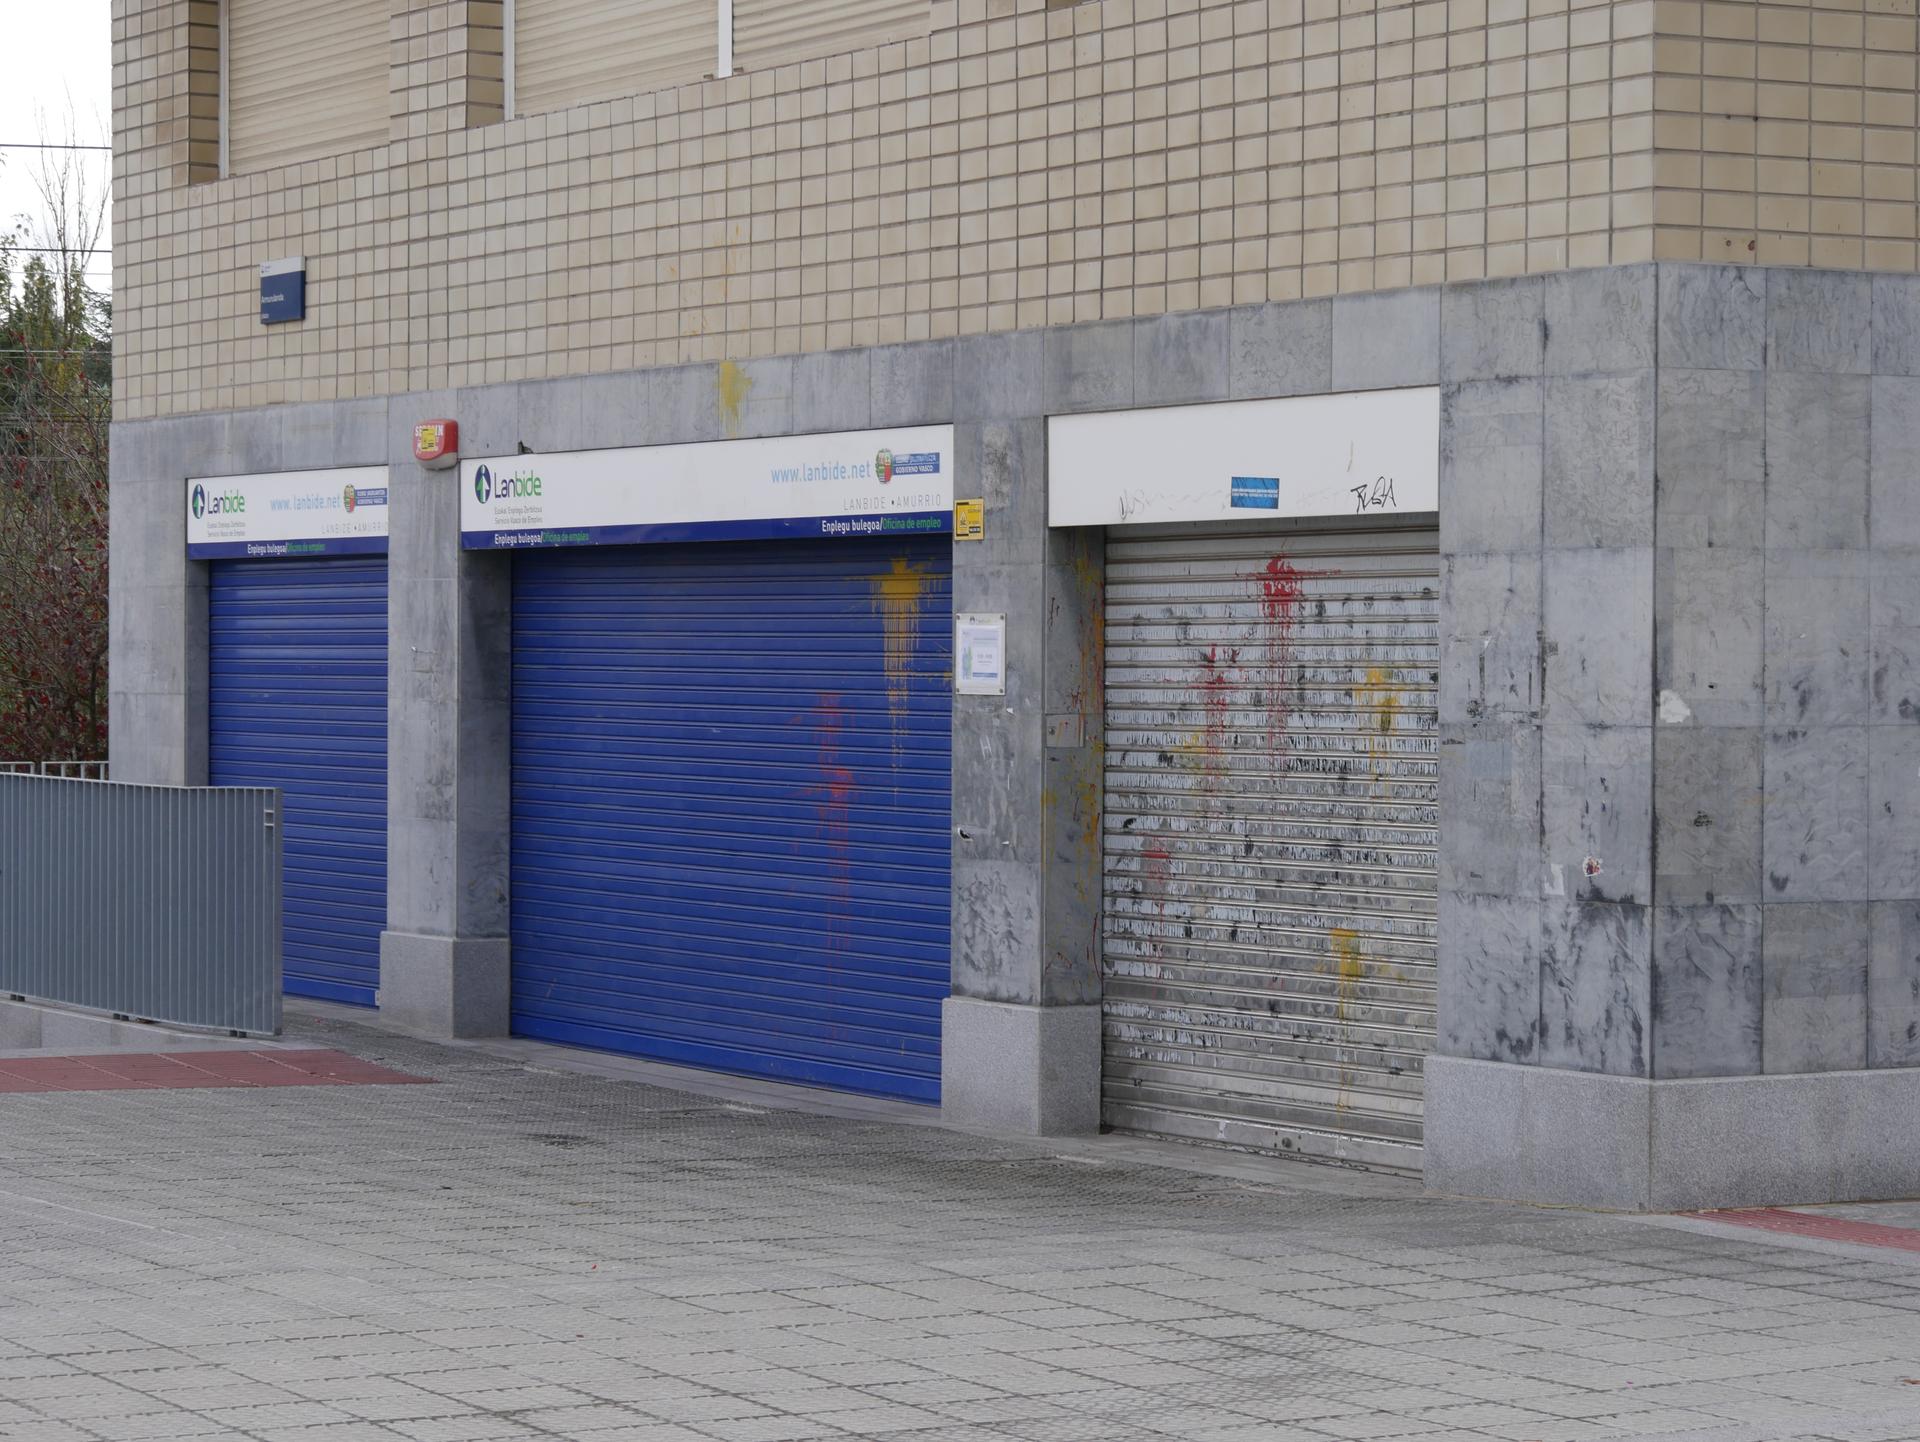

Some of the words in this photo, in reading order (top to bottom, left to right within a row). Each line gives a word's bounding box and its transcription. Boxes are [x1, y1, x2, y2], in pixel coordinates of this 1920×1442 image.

[770, 460, 871, 484] www.lanbide.net
[494, 469, 542, 498] Lanbide
[207, 489, 246, 514] Lanbide
[270, 493, 342, 511] www.lanbide.net
[843, 496, 886, 511] LANBIDE
[896, 493, 942, 508] AMURRIO
[821, 520, 851, 535] Enplegu
[906, 519, 915, 529] de
[916, 517, 942, 531] empleo
[494, 533, 518, 547] Enplegu
